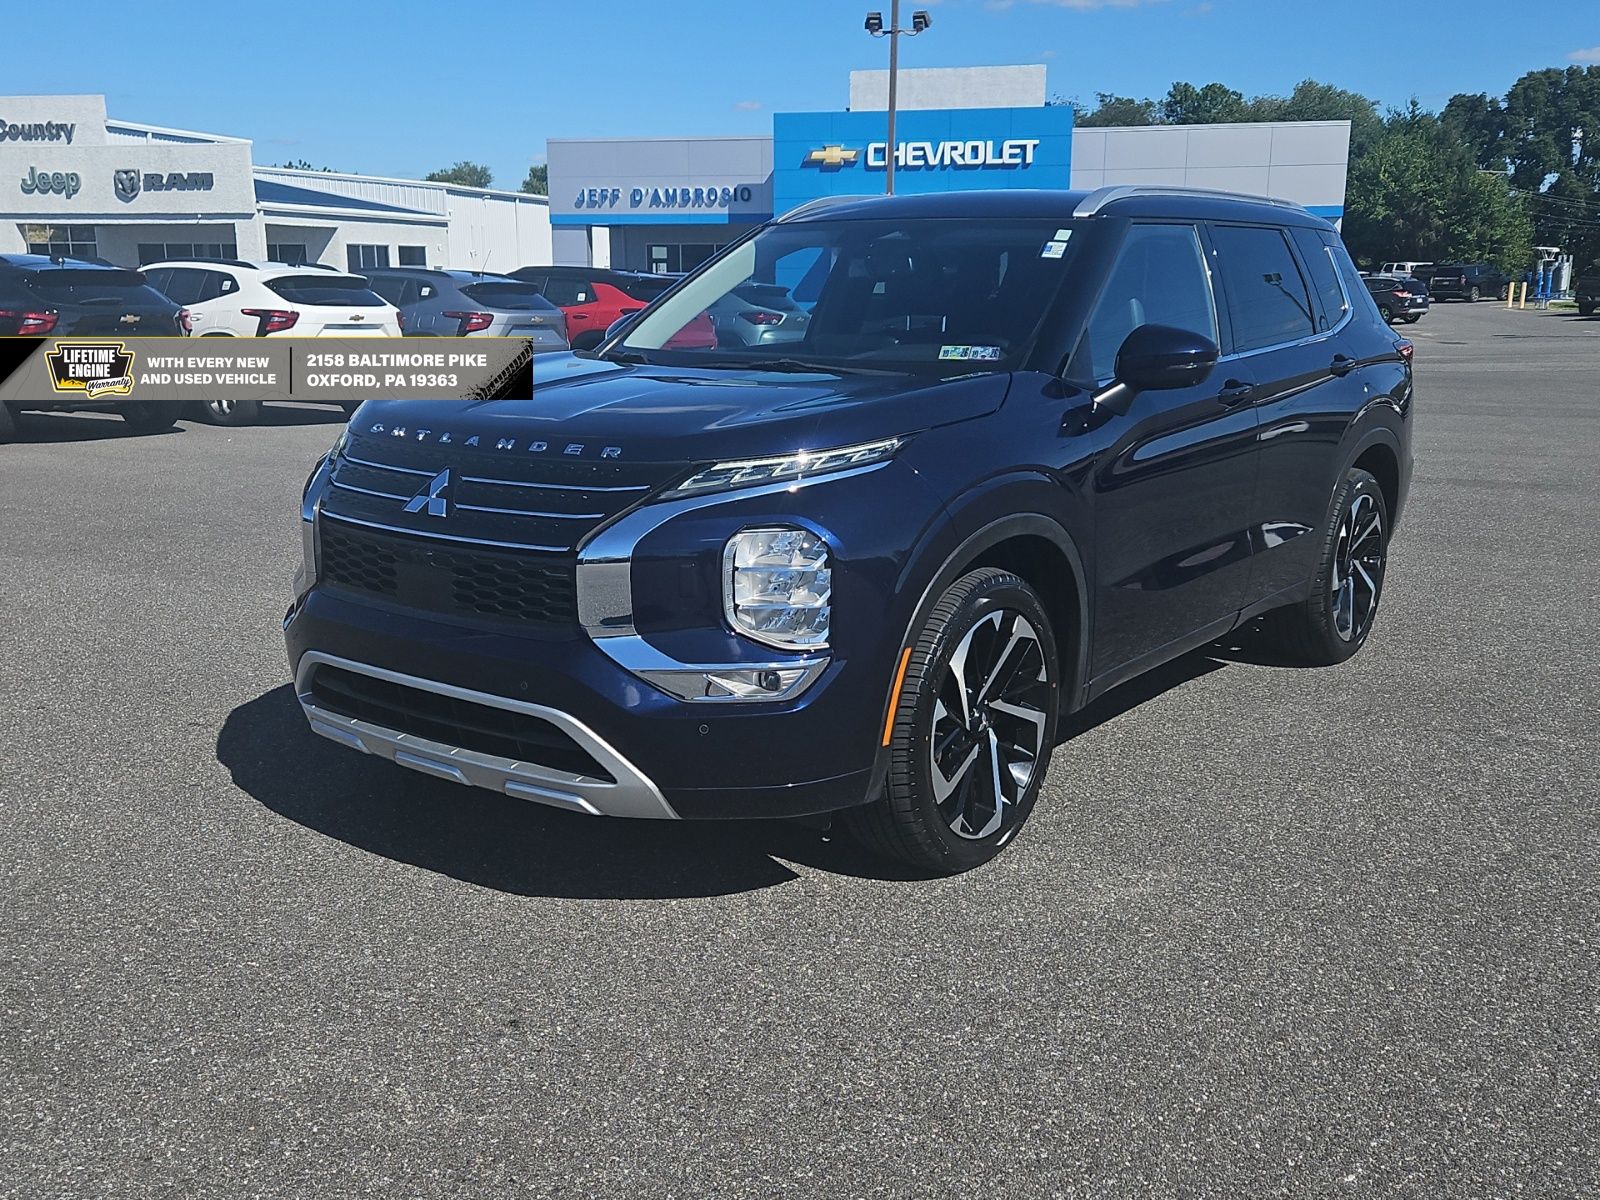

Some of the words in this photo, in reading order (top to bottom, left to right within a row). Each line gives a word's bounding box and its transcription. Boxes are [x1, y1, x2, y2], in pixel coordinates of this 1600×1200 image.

[866, 140, 1040, 167] CHEVROLET
[20, 166, 81, 199] Jeep
[143, 173, 214, 191] RAM
[576, 188, 621, 204] JEFF
[631, 187, 752, 204] D'AMBROSIO
